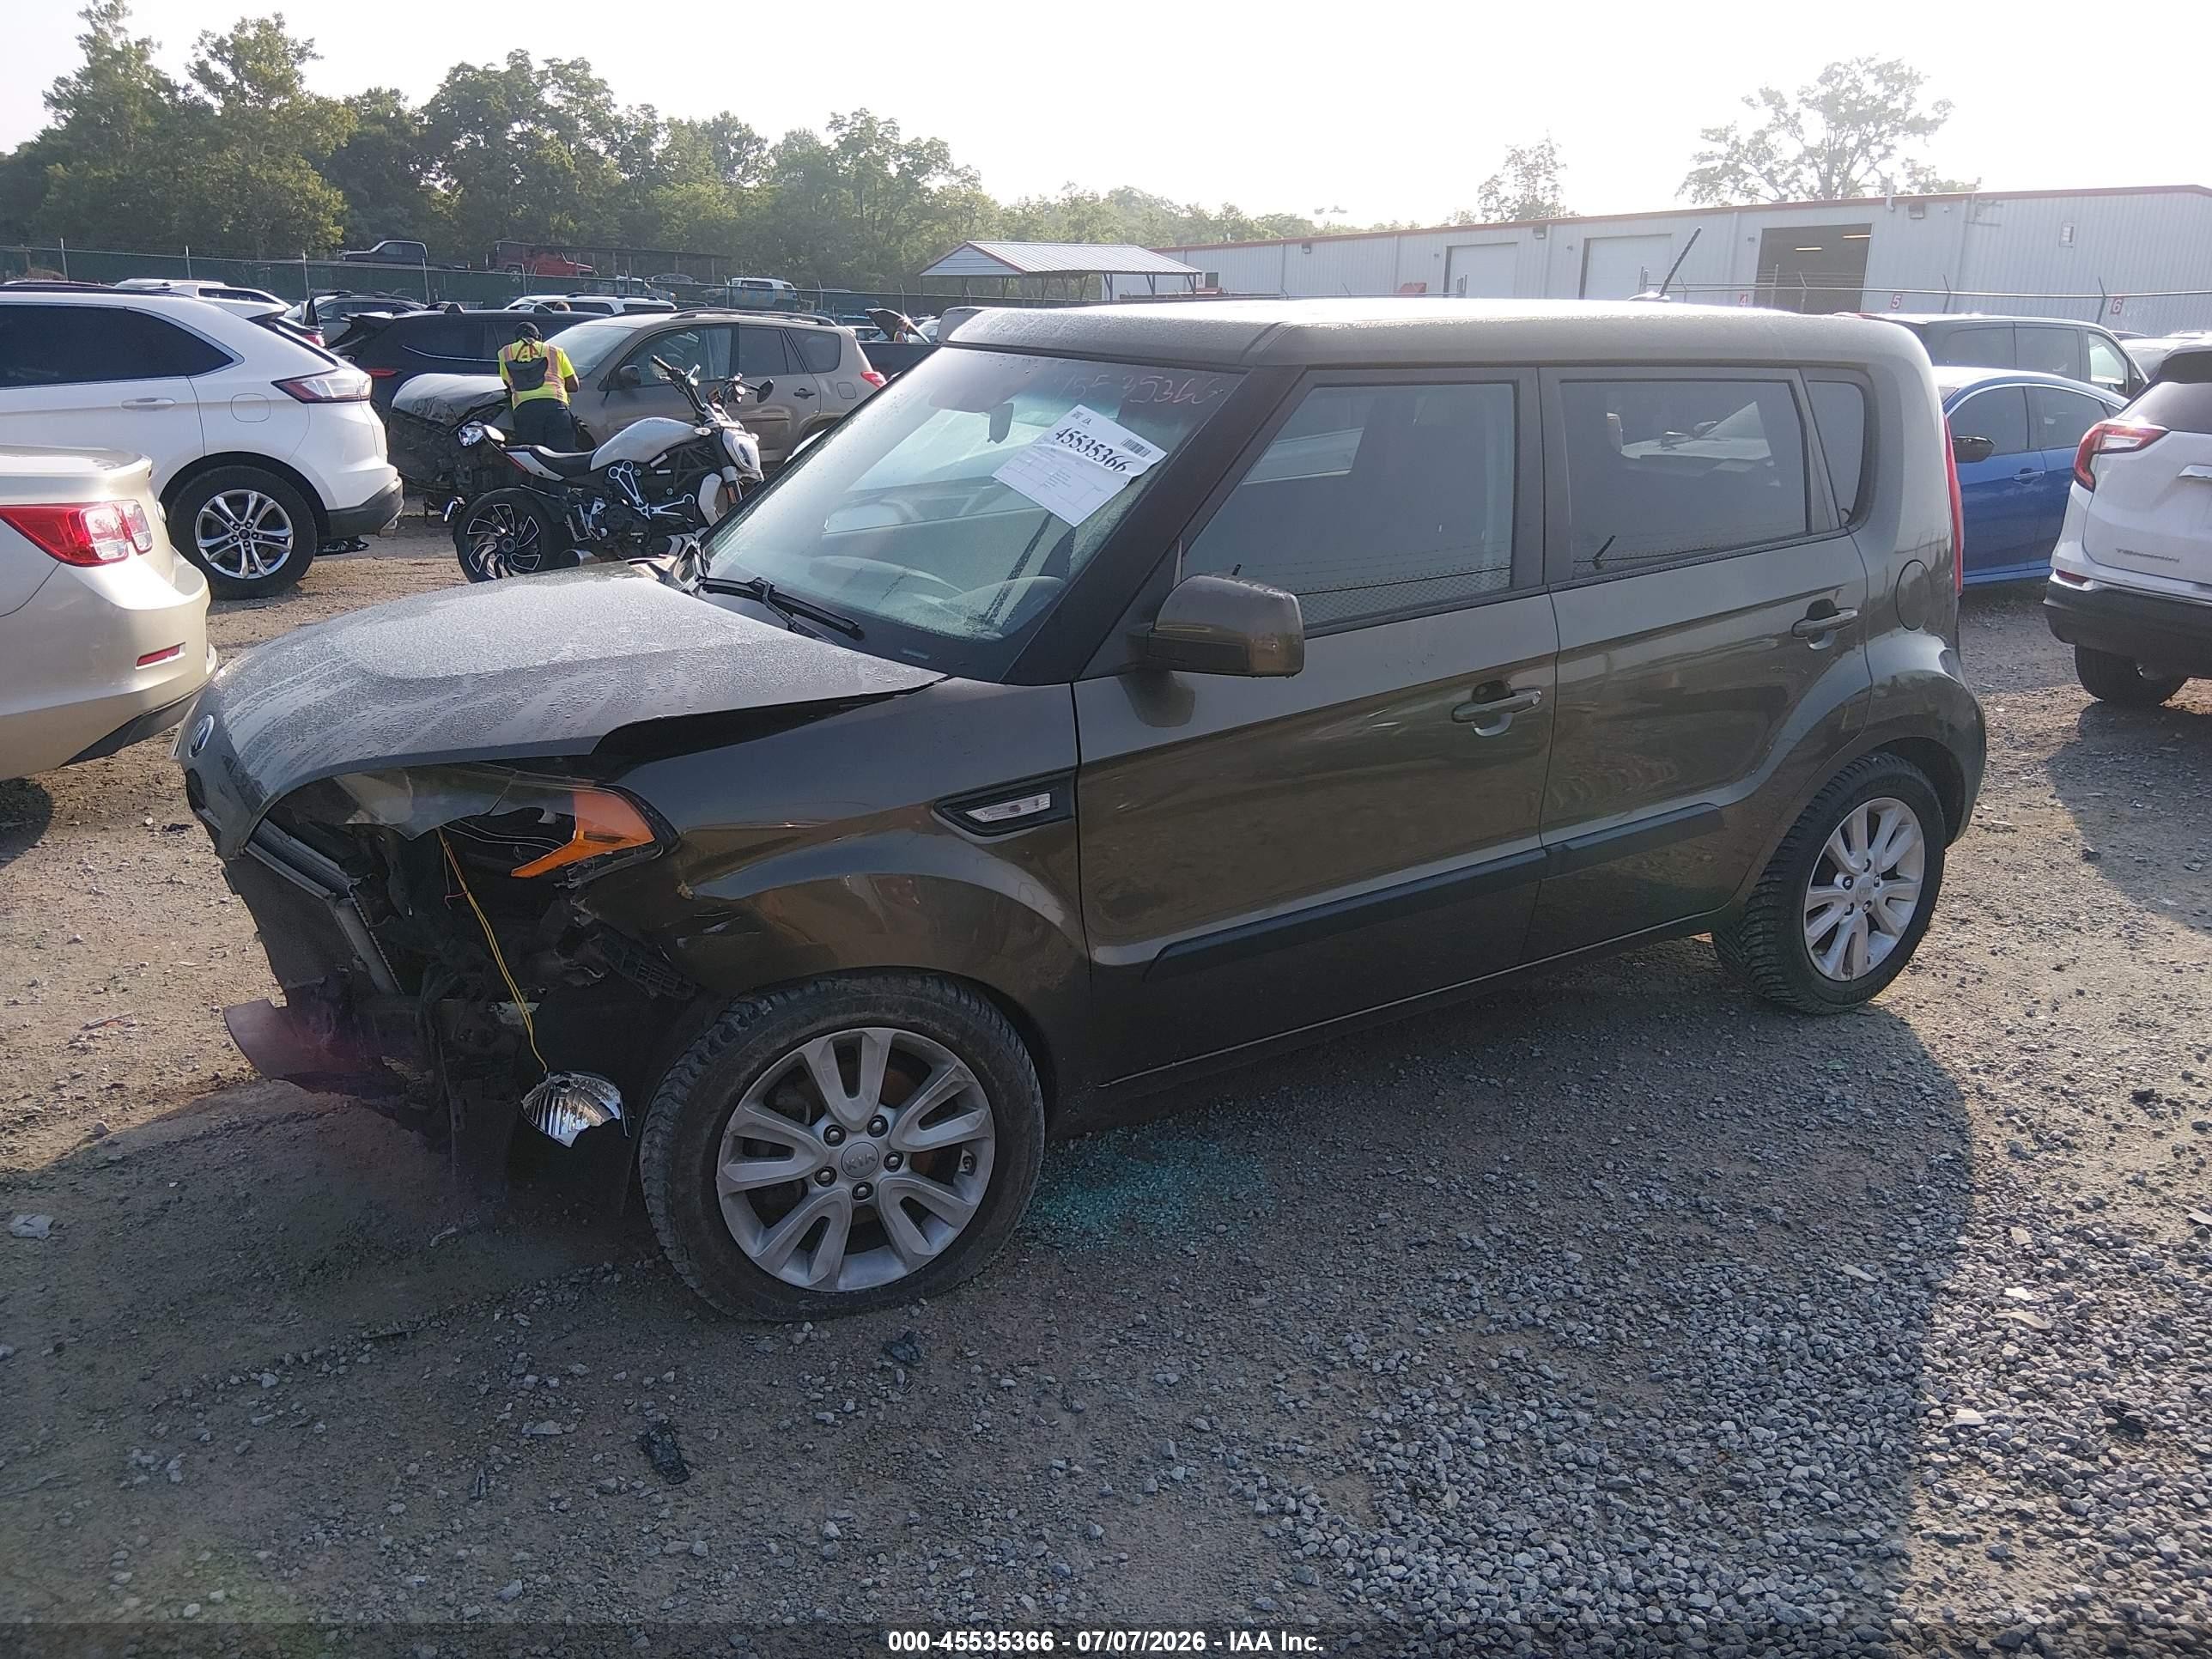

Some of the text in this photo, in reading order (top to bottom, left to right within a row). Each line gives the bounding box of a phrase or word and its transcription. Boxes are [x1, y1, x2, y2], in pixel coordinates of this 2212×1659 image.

[1892, 295, 1900, 307] 5
[2112, 299, 2122, 313] 6
[1055, 428, 1133, 471] 45535366
